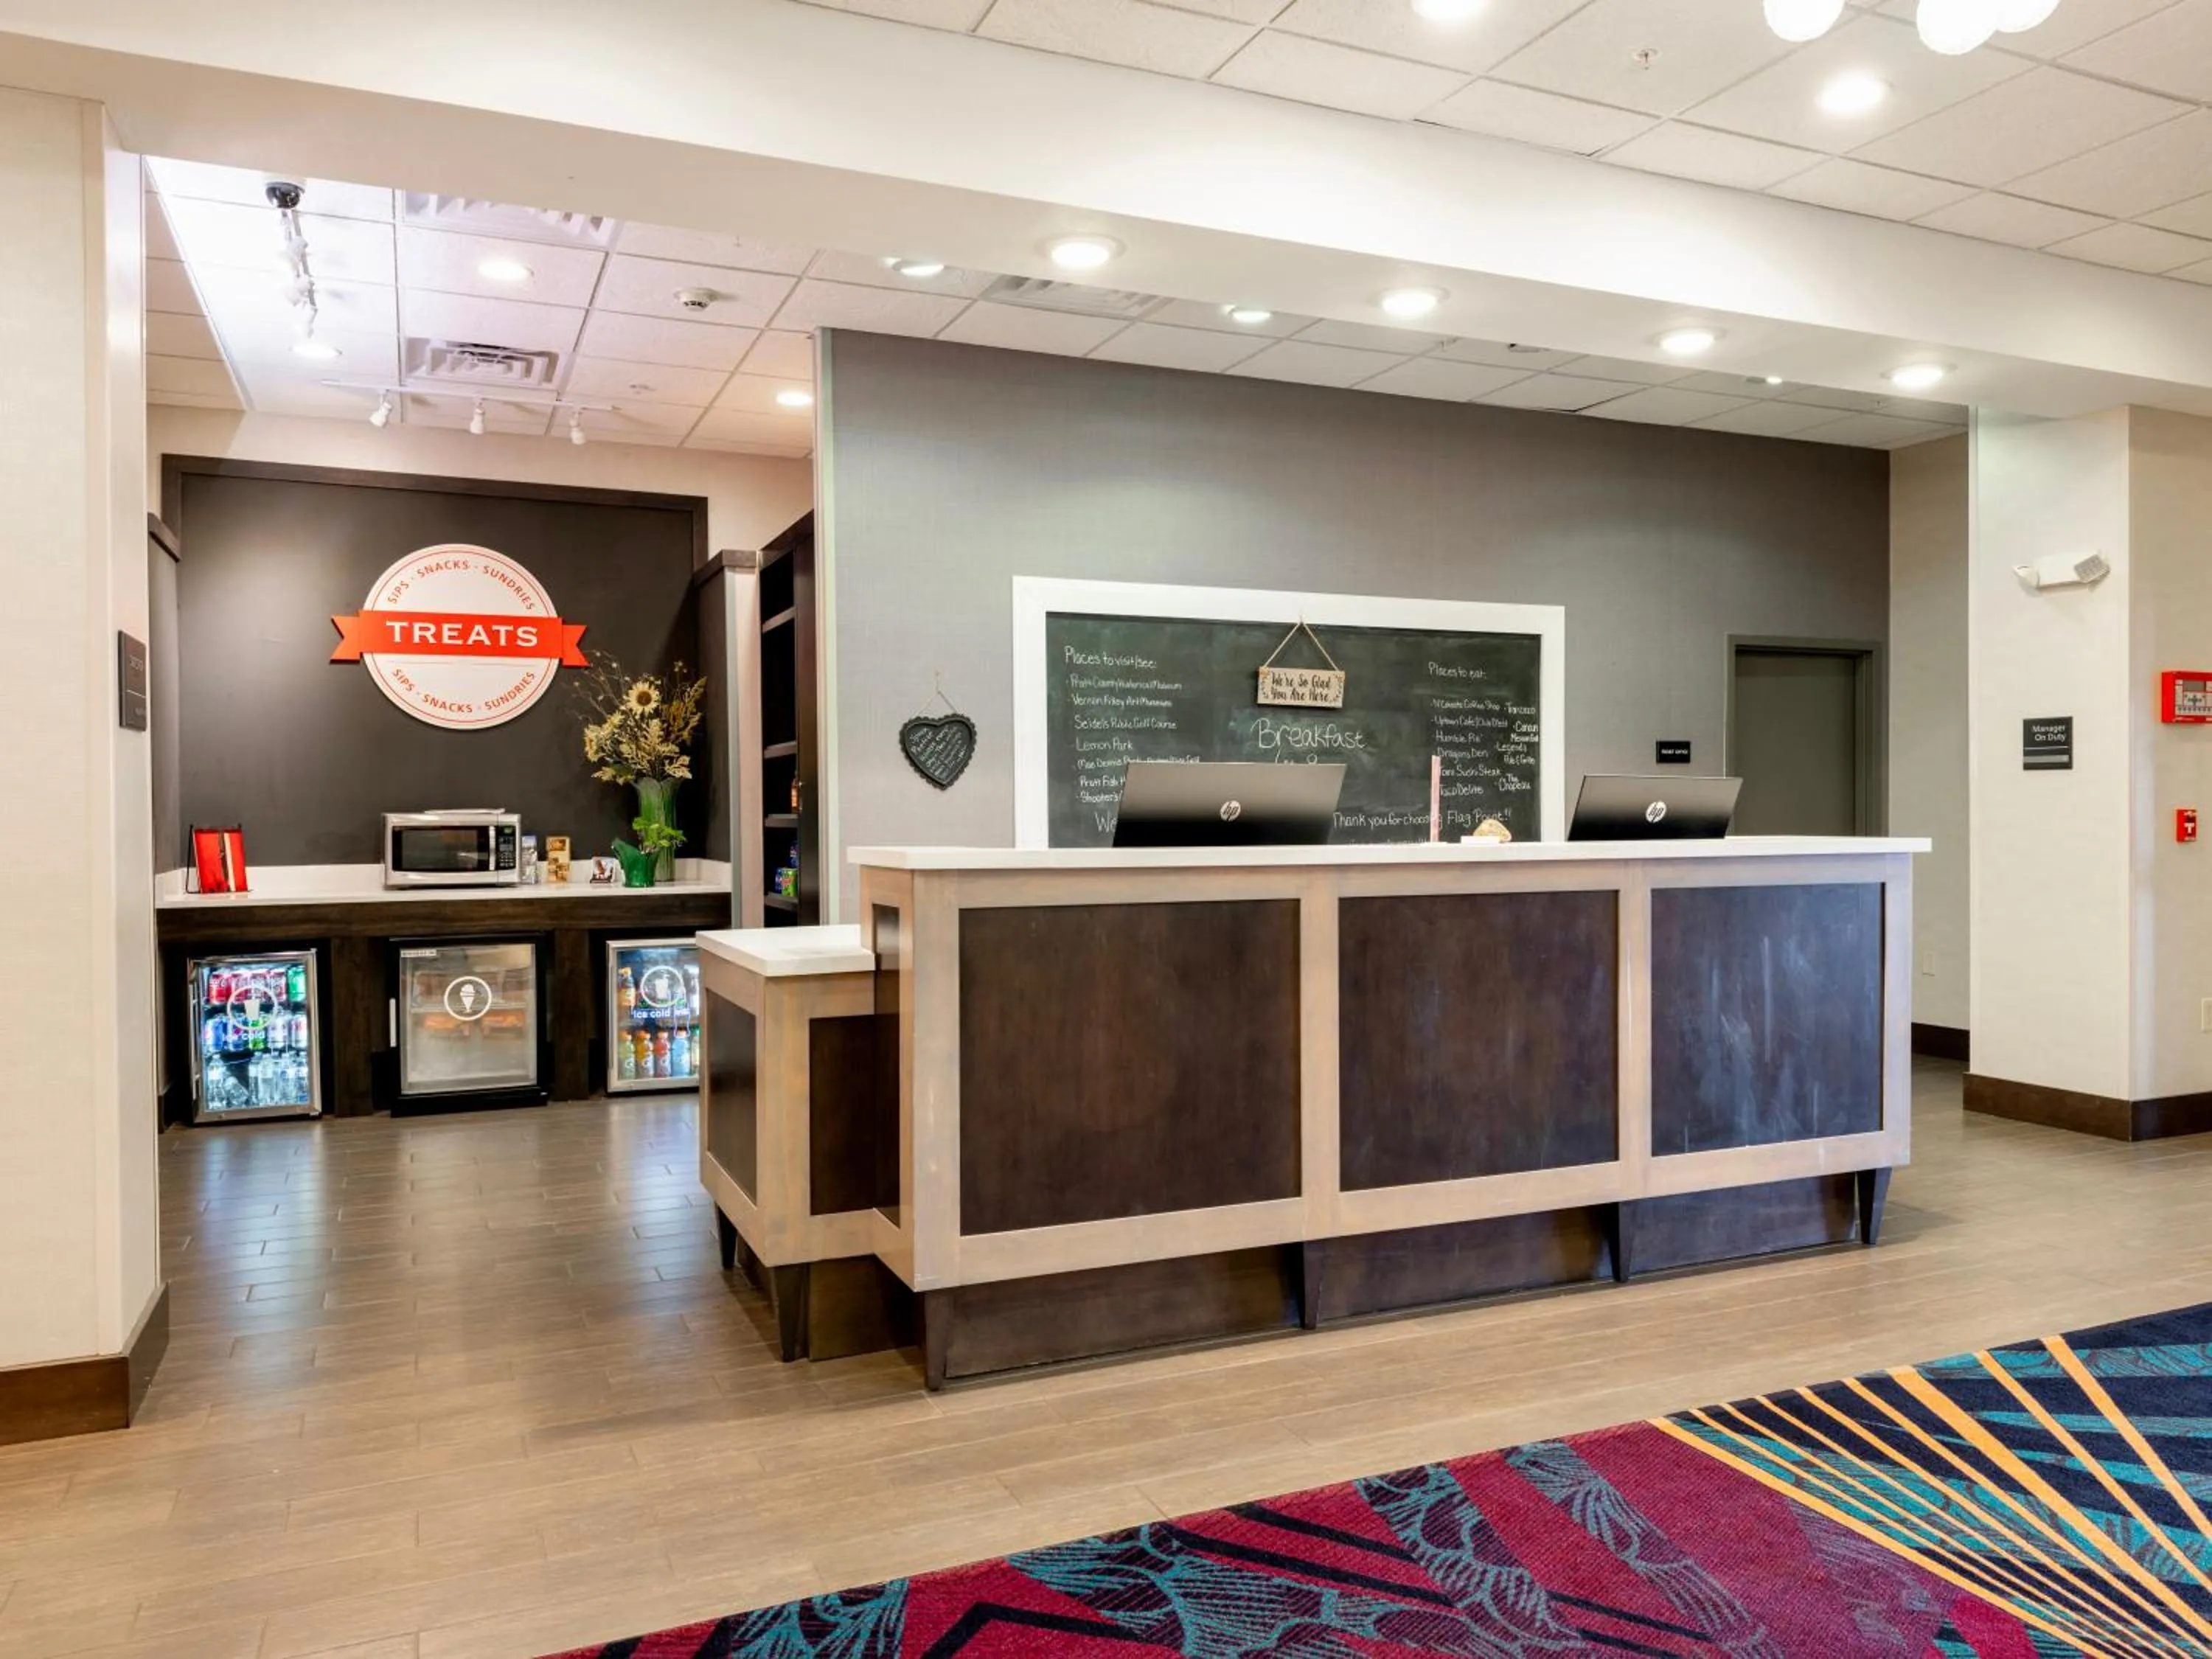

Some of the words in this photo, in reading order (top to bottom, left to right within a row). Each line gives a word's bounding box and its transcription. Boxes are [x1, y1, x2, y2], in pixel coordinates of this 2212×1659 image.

[387, 580, 410, 605] SIPS
[417, 560, 470, 579] SNACKS
[483, 566, 536, 611] SUNDRIES
[386, 621, 538, 647] TREATS
[1064, 645, 1101, 664] Places
[1103, 651, 1114, 666] to
[1427, 661, 1458, 678] Places
[1458, 666, 1468, 679] to
[1271, 671, 1294, 687] We're
[1298, 673, 1309, 687] So
[1312, 674, 1332, 689] Glad
[392, 669, 415, 692] SIPS
[422, 695, 473, 713] SNACKS
[484, 672, 536, 711] SUNDRIES
[1270, 686, 1287, 700] You
[1290, 687, 1305, 701] Are
[1250, 717, 1367, 748] Breakfast
[2031, 724, 2066, 734] Manager
[2034, 734, 2046, 742] On
[2048, 733, 2066, 743] Duty
[1075, 737, 1110, 751] Lemon
[1112, 737, 1134, 751] Park
[1471, 747, 1489, 758] Den
[1333, 812, 1367, 831] Thank
[1368, 815, 1387, 831] you
[1387, 813, 1403, 826] for
[1403, 813, 1444, 831] choosg
[1447, 809, 1472, 829] Flag
